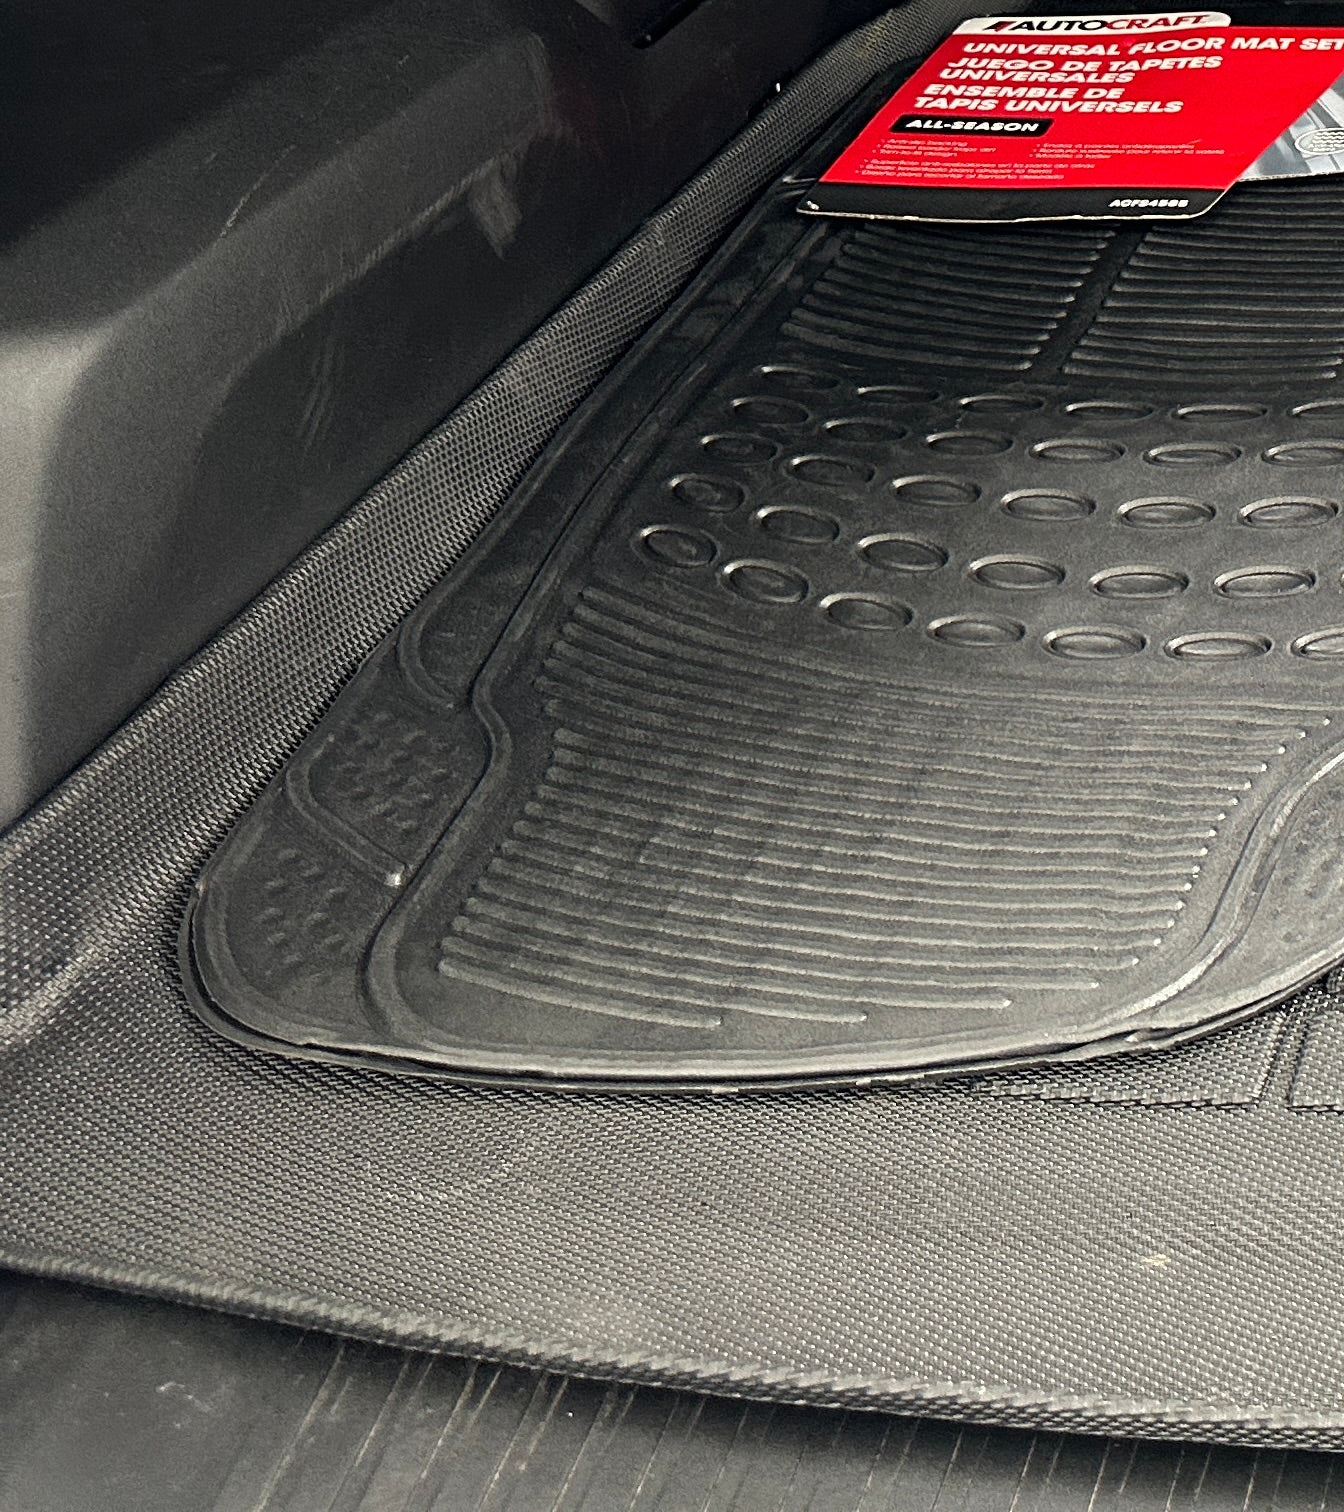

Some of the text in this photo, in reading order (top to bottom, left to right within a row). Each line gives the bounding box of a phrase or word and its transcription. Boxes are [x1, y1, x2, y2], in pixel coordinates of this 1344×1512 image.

[1009, 14, 1213, 31] AUTOCRAFT
[963, 42, 1121, 56] UNIVERSAL
[1128, 37, 1226, 55] FLOOR
[1231, 37, 1295, 50] MAT
[948, 56, 1223, 72] JUEGO DE TAPETES
[939, 68, 1135, 84] UNIVERSALES
[923, 84, 1125, 99] ENSEMBLE DE
[914, 96, 1184, 113] TAPIS UNIVERSELS
[905, 119, 1039, 132] ALL-SEASON
